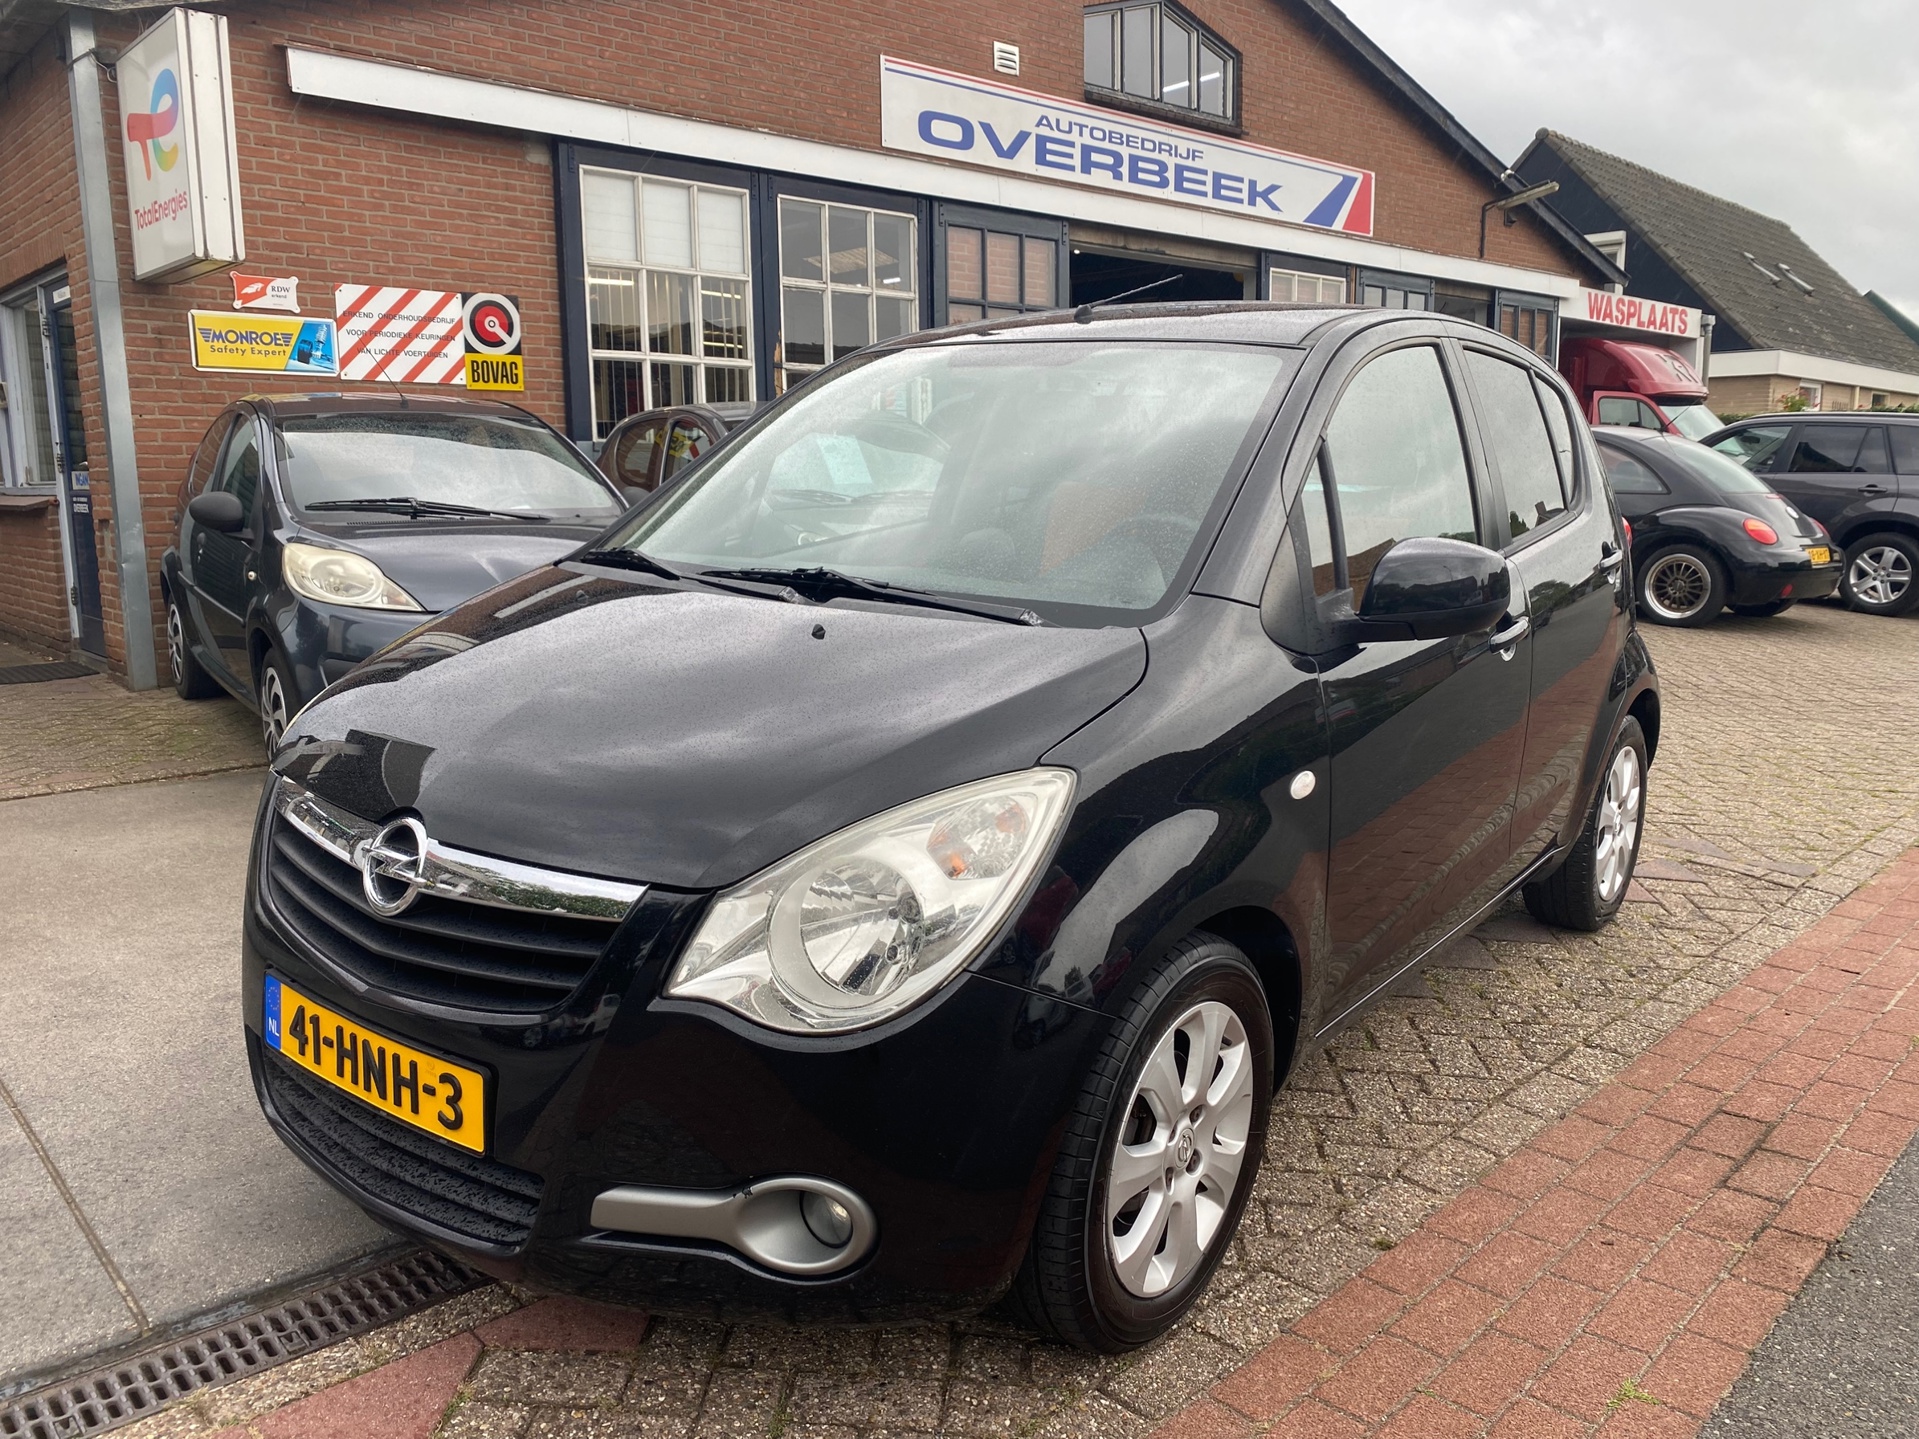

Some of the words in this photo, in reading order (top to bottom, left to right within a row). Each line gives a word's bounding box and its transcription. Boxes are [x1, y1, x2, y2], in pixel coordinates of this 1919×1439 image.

[1034, 114, 1204, 162] AUTOBEDRIJF
[917, 109, 1284, 213] OVERBEEK
[134, 188, 188, 231] TotalEnergies
[271, 285, 290, 293] RDW
[342, 310, 374, 319] ERKEND
[377, 312, 456, 324] ONDERHOUDSBEDRIJF
[1587, 291, 1688, 335] WASPLAATS
[210, 329, 283, 346] MONROE
[345, 328, 367, 337] VOOR
[369, 330, 413, 339] PERIODIEKE
[415, 333, 456, 342] KEURINGEN
[210, 345, 247, 356] Safety
[250, 348, 287, 358] Expert
[356, 346, 372, 355] VAN
[374, 348, 400, 356] LICHTE
[403, 350, 448, 359] VOERTUIGEN
[470, 359, 519, 385] BOVAG
[268, 1017, 280, 1037] NL
[289, 1004, 464, 1131] 41-HNH-3
